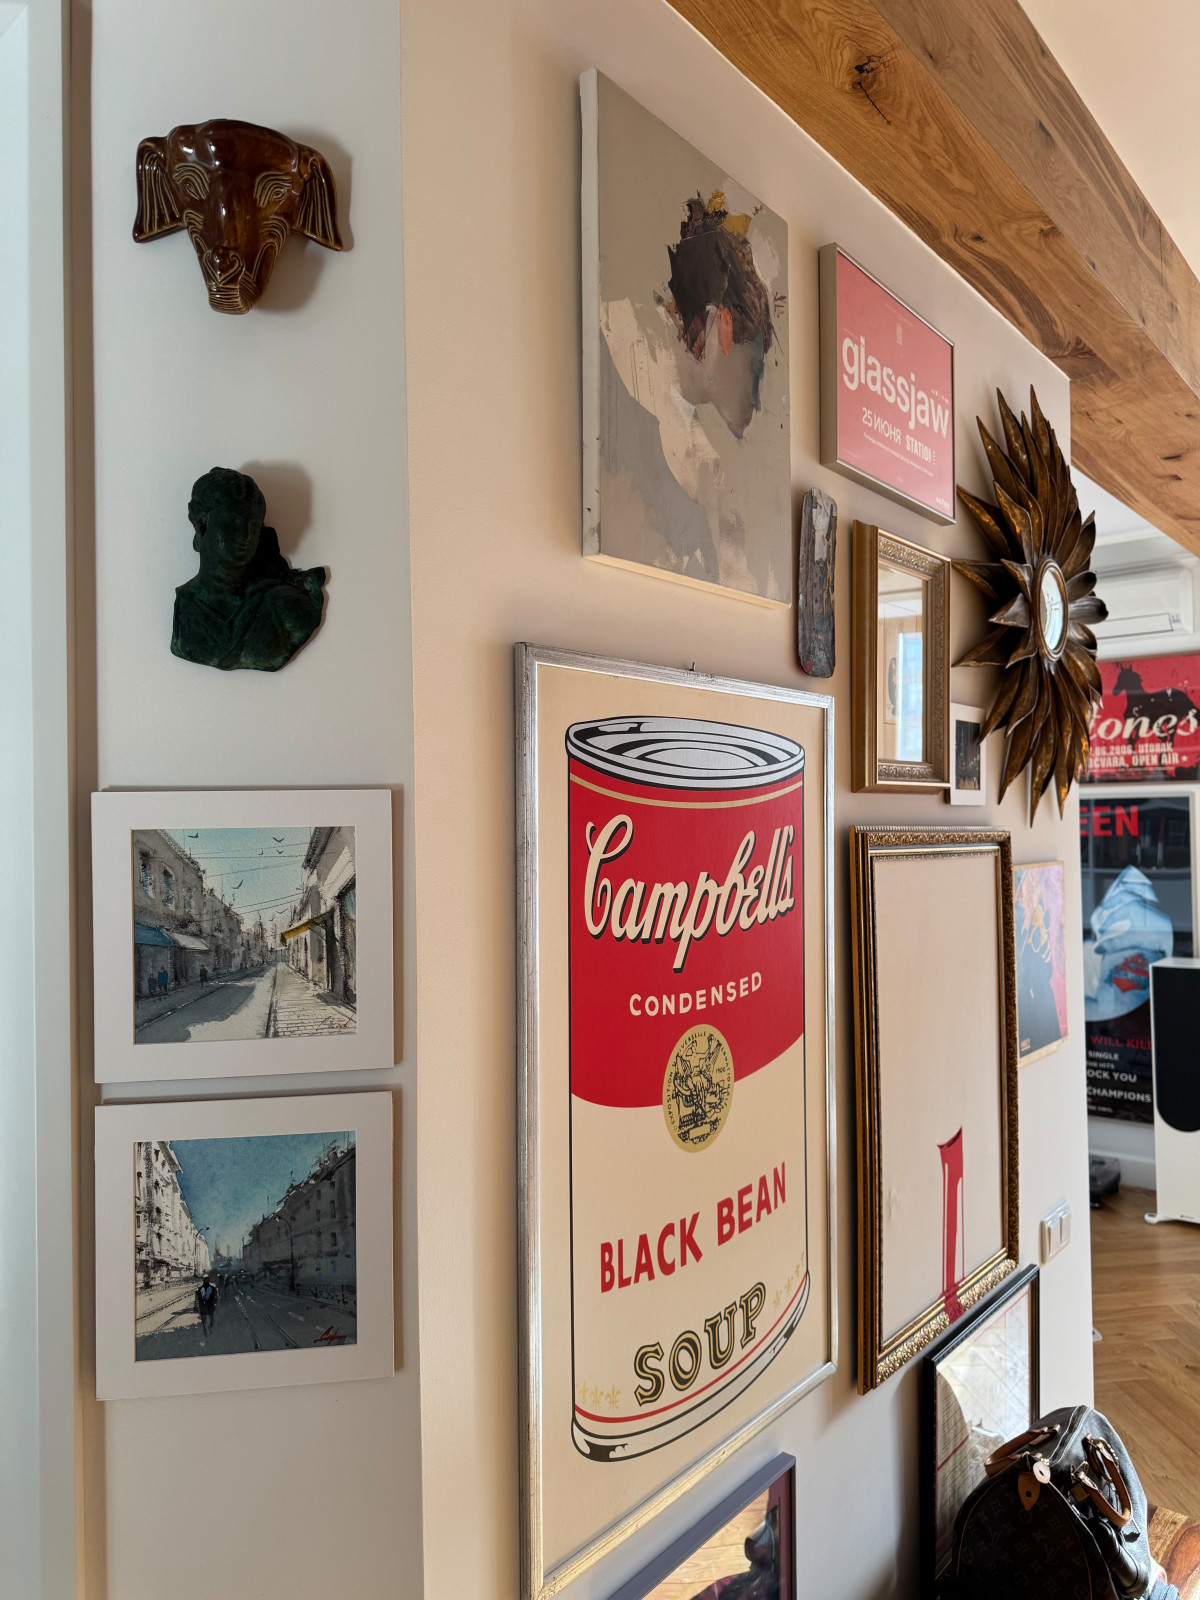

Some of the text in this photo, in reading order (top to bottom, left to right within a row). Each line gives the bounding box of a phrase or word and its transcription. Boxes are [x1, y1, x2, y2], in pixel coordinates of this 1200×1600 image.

[842, 335, 950, 438] glassjaw
[862, 407, 901, 445] 25 ИЮНЯ
[1132, 753, 1158, 766] OPEN
[1161, 752, 1180, 765] AIR
[629, 971, 763, 1017] CONDENSED
[1090, 1035, 1123, 1048] WILL
[1087, 1050, 1119, 1062] SINGLE
[1112, 1071, 1137, 1083] YOU
[1086, 1086, 1152, 1103] CHAMPIONS
[599, 1161, 786, 1294] BLACK BEAN
[633, 1281, 766, 1407] SOUP
